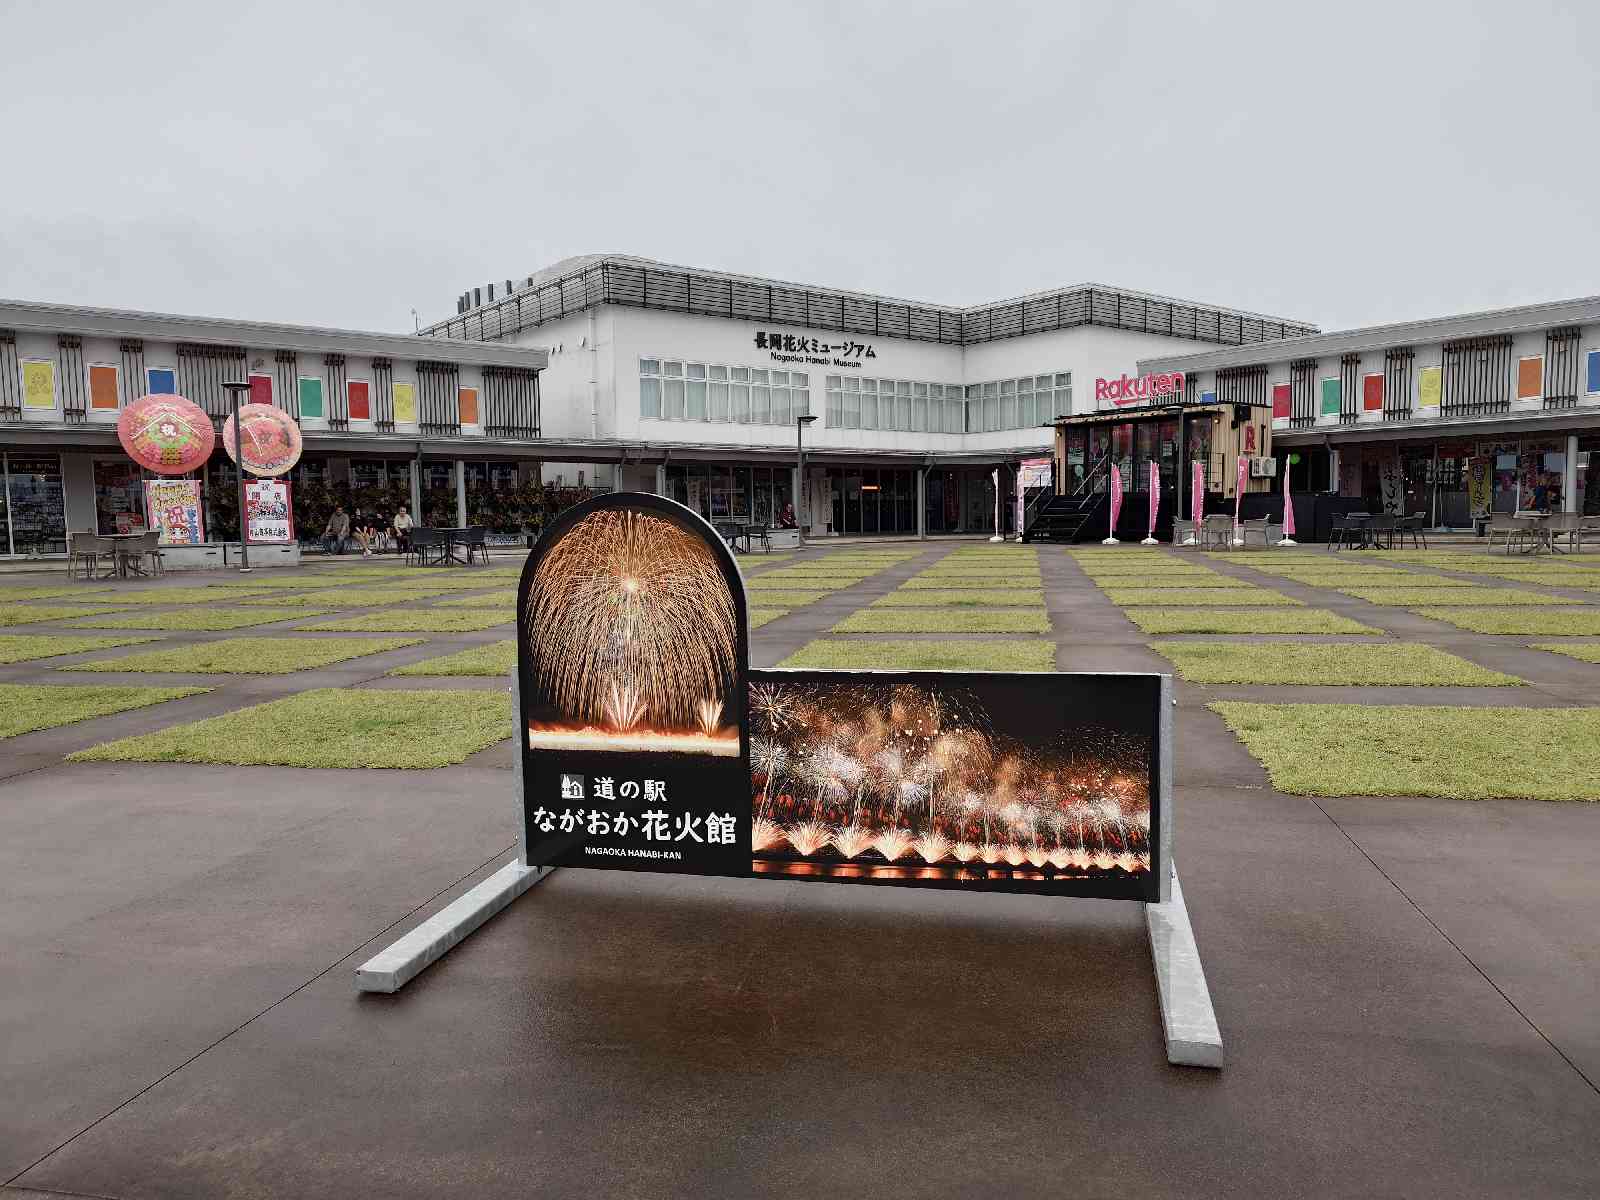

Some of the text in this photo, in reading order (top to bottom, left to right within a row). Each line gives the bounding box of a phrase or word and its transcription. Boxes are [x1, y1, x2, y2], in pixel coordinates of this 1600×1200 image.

[754, 331, 876, 358] 長岡花火ミュージアム
[770, 352, 862, 368] Nagaoka Hanabi Museum
[1095, 371, 1185, 400] Rakuten
[593, 777, 668, 801] 道の駅
[533, 806, 737, 844] ながおか花火館
[585, 846, 682, 860] NAGAOKA HANABI-KAN
